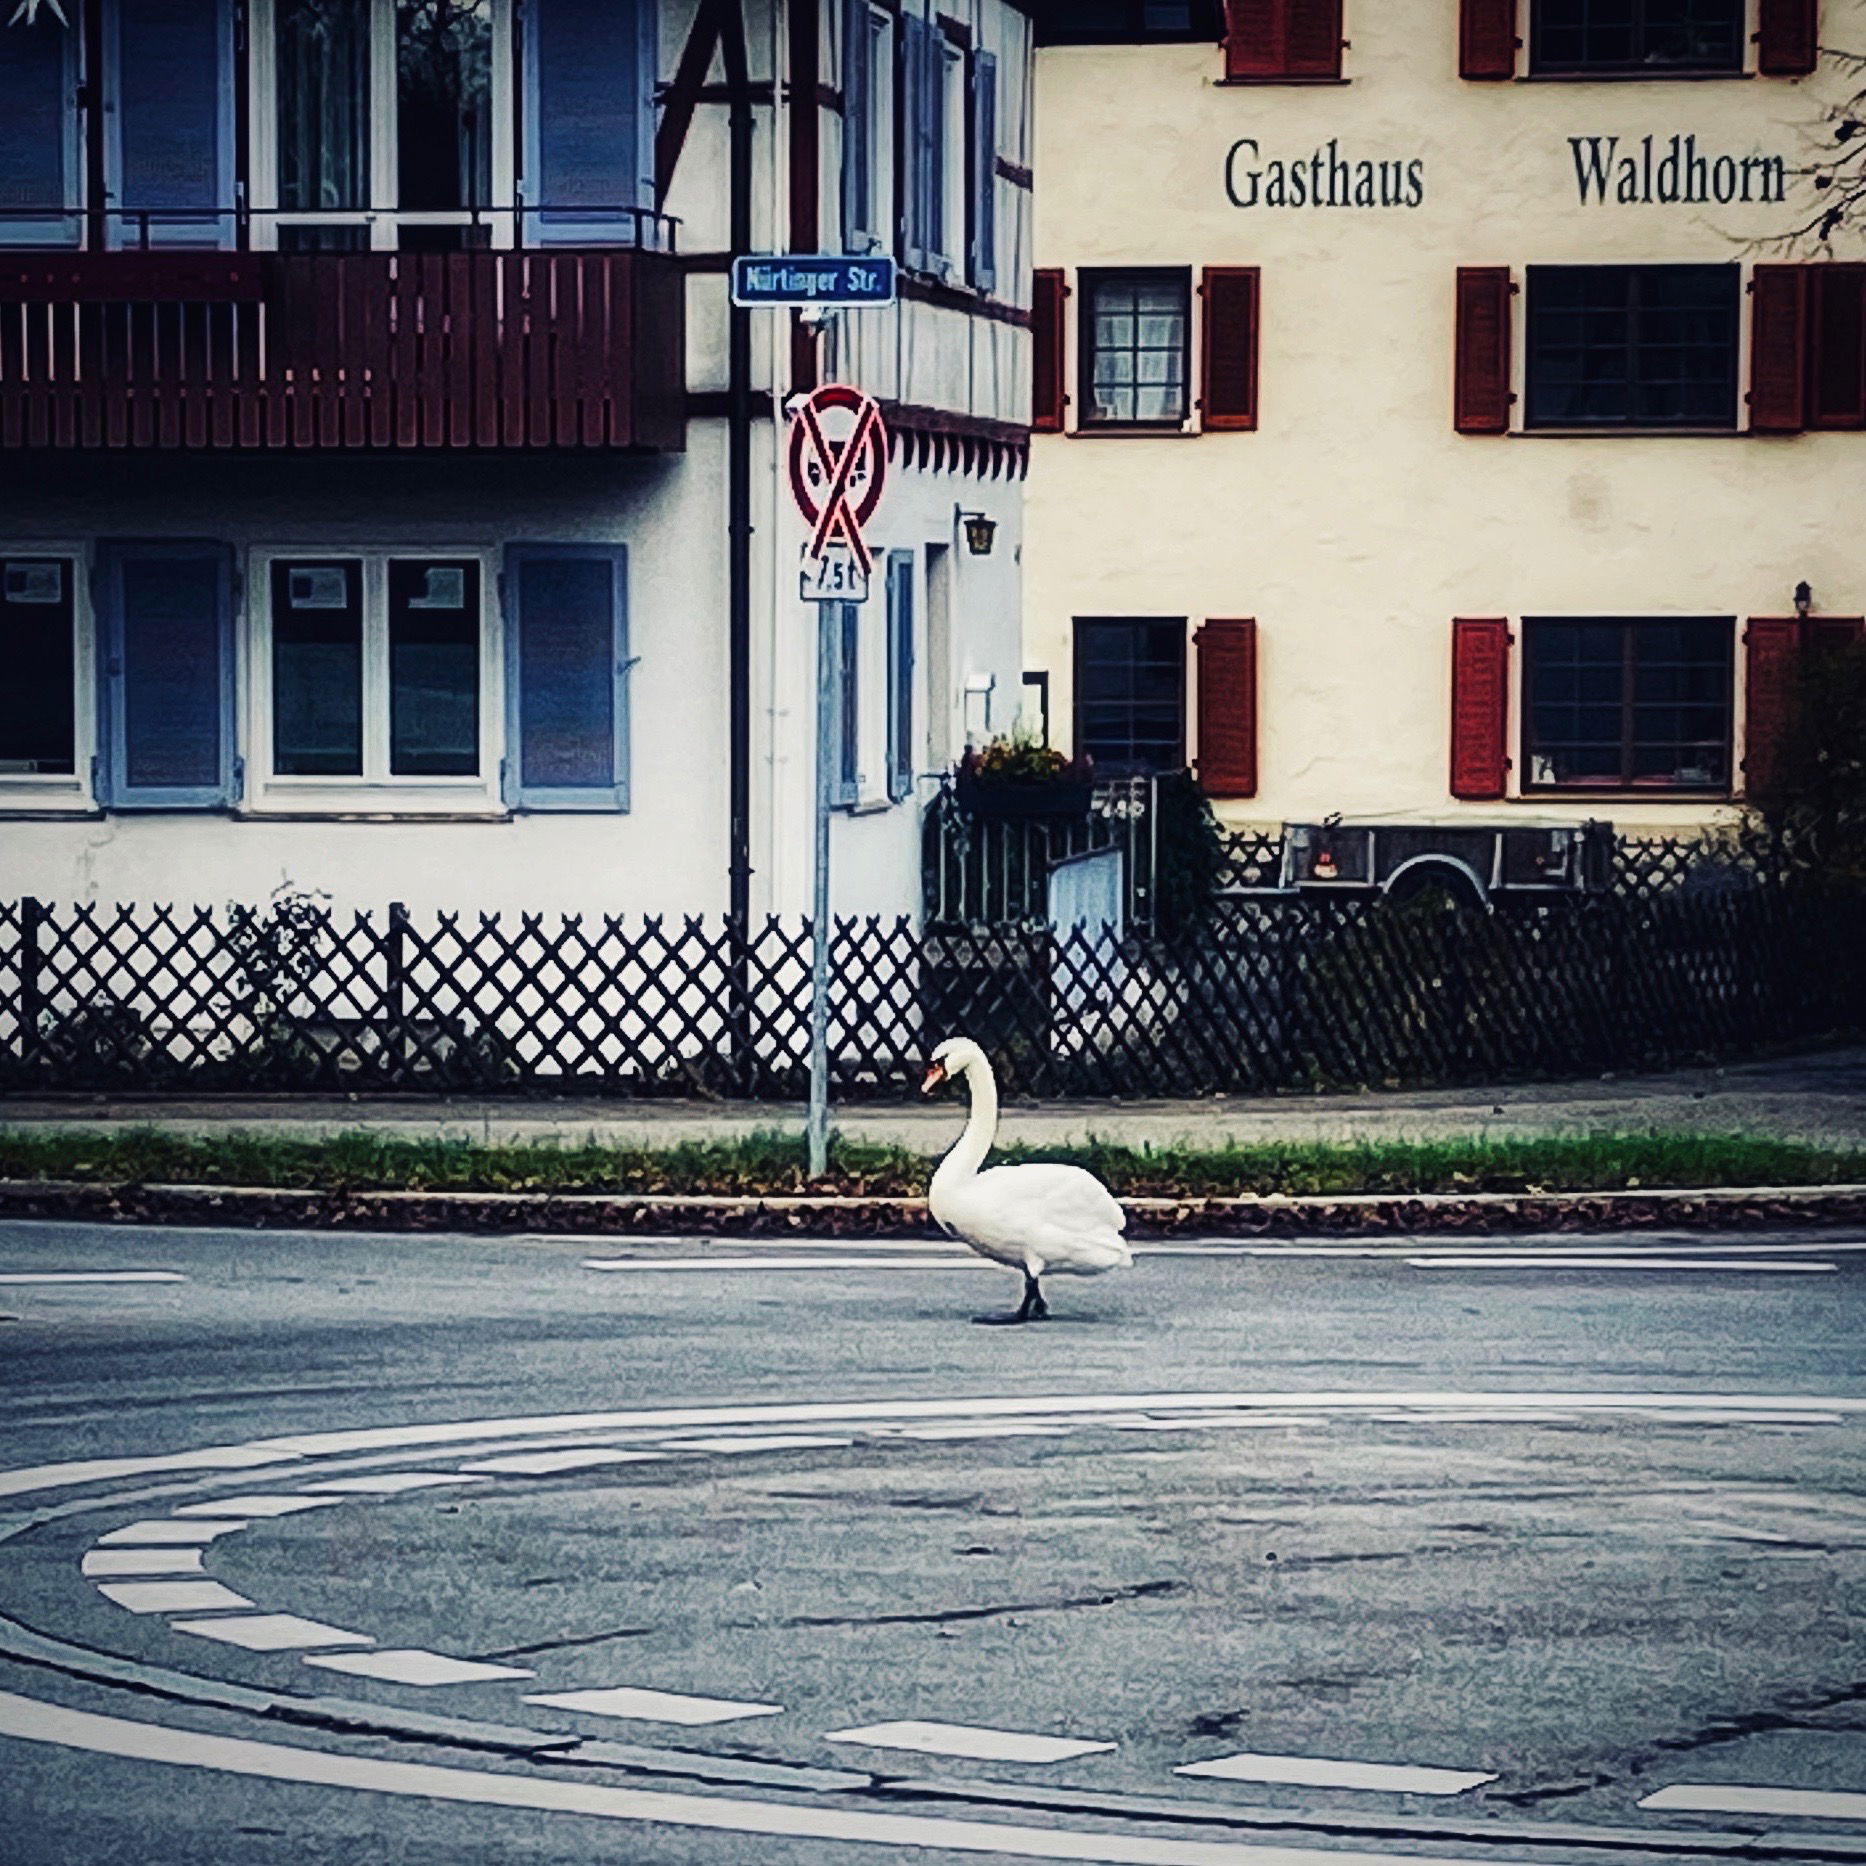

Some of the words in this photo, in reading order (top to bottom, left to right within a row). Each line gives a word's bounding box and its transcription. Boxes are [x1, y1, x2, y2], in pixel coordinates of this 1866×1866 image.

[1225, 138, 1424, 208] Gasthaus
[1567, 134, 1787, 206] Waldhorn
[746, 265, 839, 297] Nürtinger
[847, 266, 883, 292] Str.
